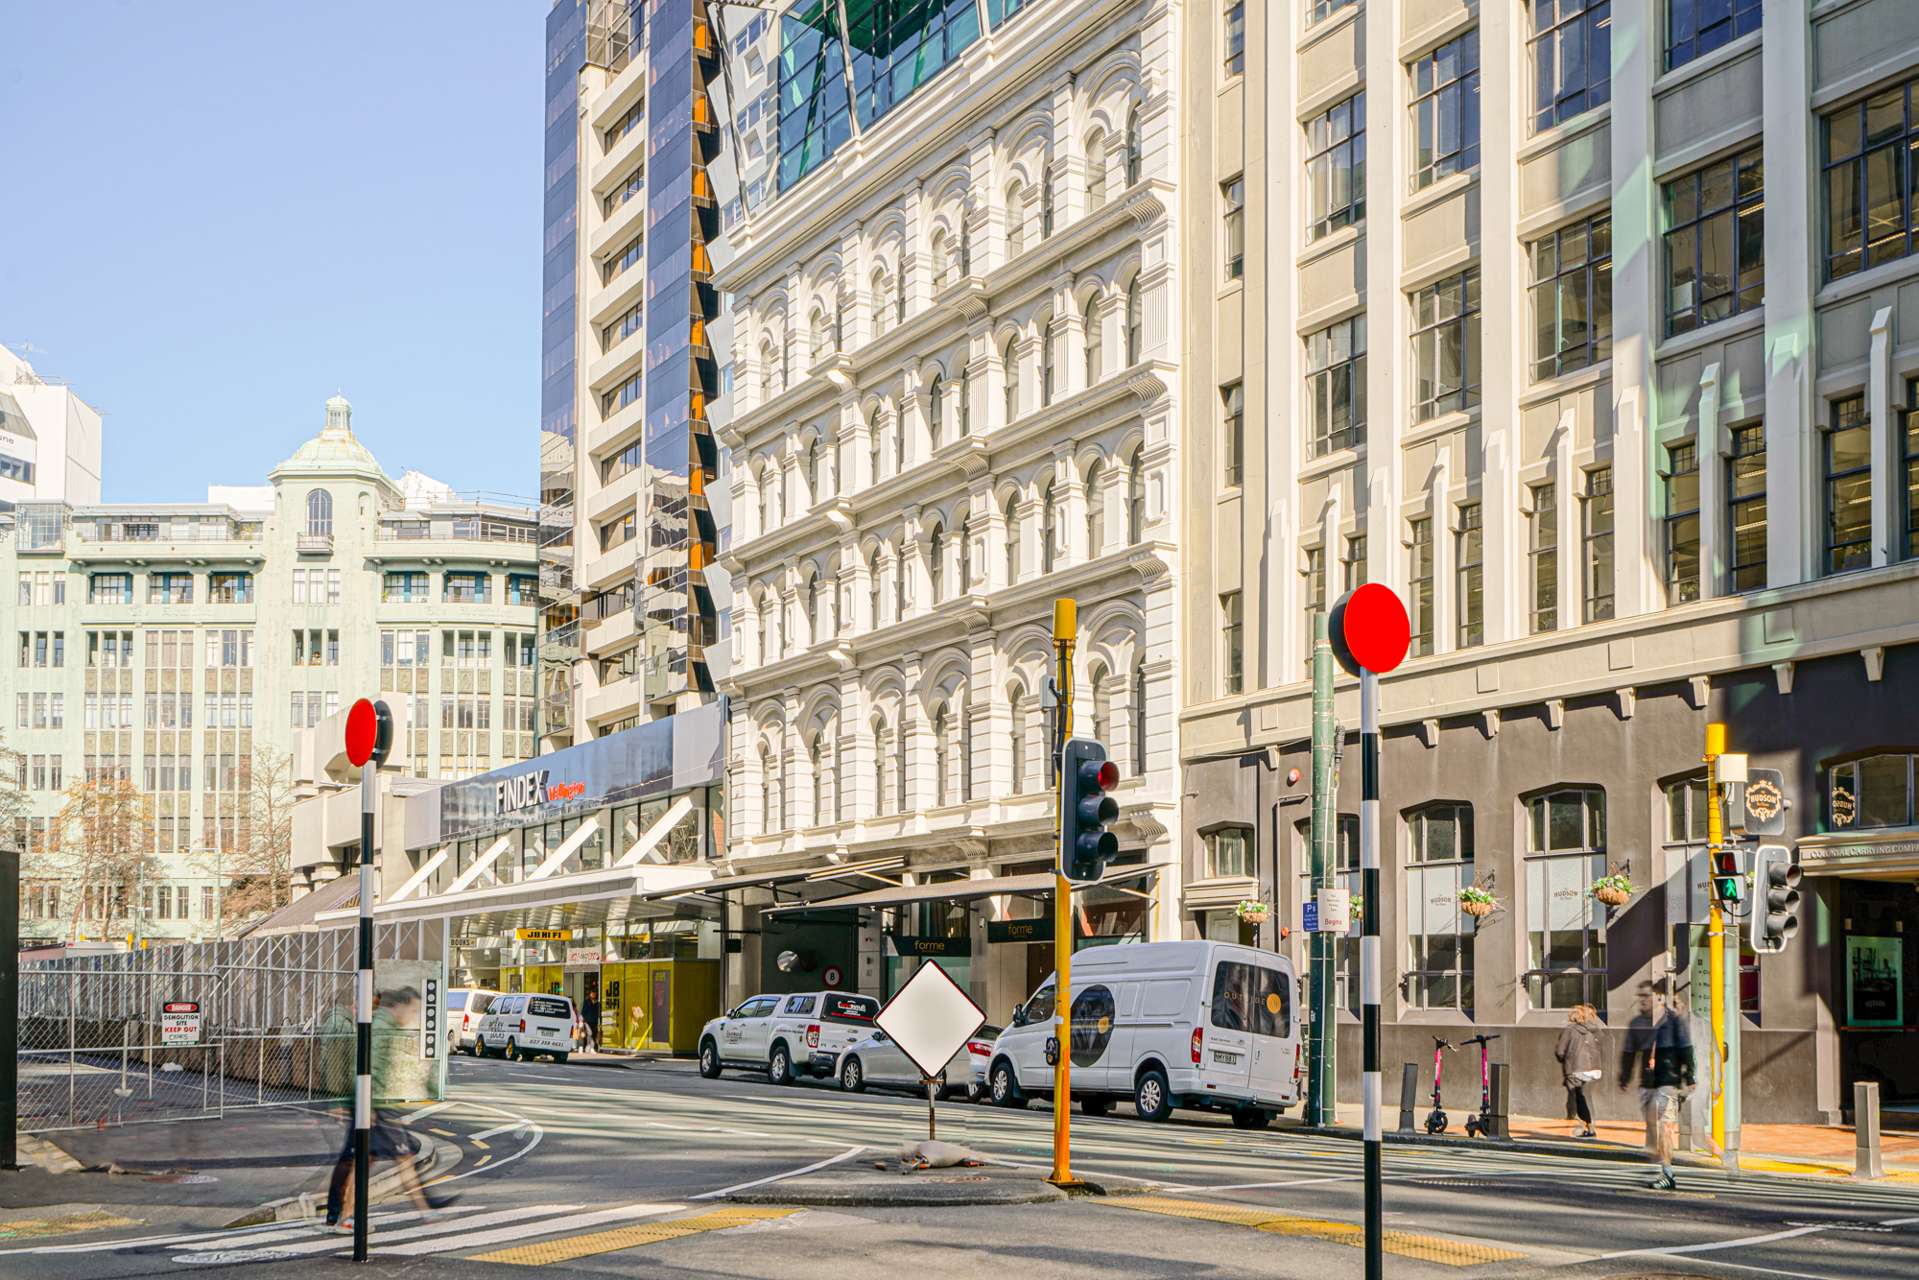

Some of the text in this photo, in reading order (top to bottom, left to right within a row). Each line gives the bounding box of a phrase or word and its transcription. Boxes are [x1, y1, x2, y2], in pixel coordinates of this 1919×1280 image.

[496, 768, 544, 815] FINDEX
[914, 940, 945, 951] forme
[606, 981, 619, 997] JB
